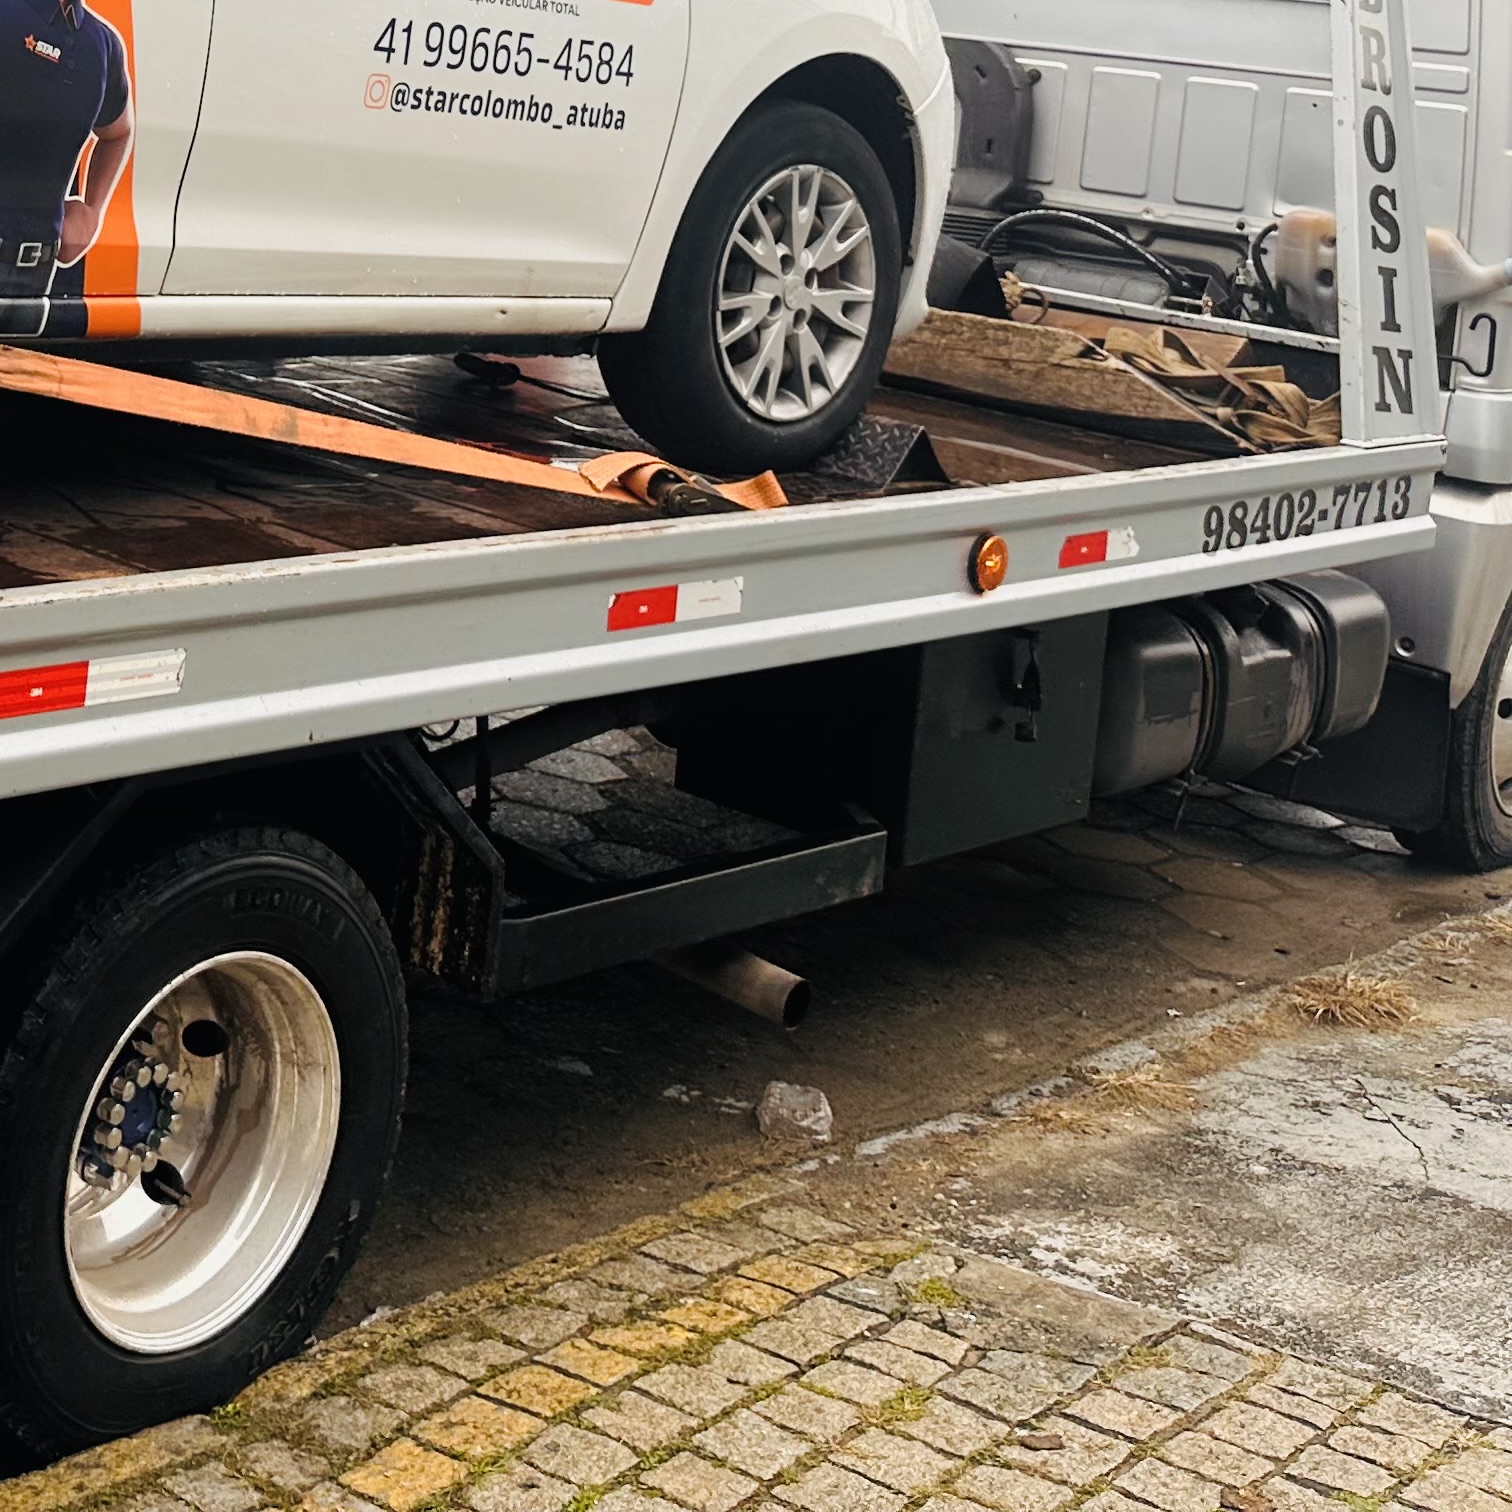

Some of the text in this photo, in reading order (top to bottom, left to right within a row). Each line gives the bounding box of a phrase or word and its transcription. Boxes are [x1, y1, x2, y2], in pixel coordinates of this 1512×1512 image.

[549, 0, 581, 17] TOTAL
[389, 81, 626, 131] @starcolombo_atuba
[1202, 473, 1412, 556] 98402-7713
